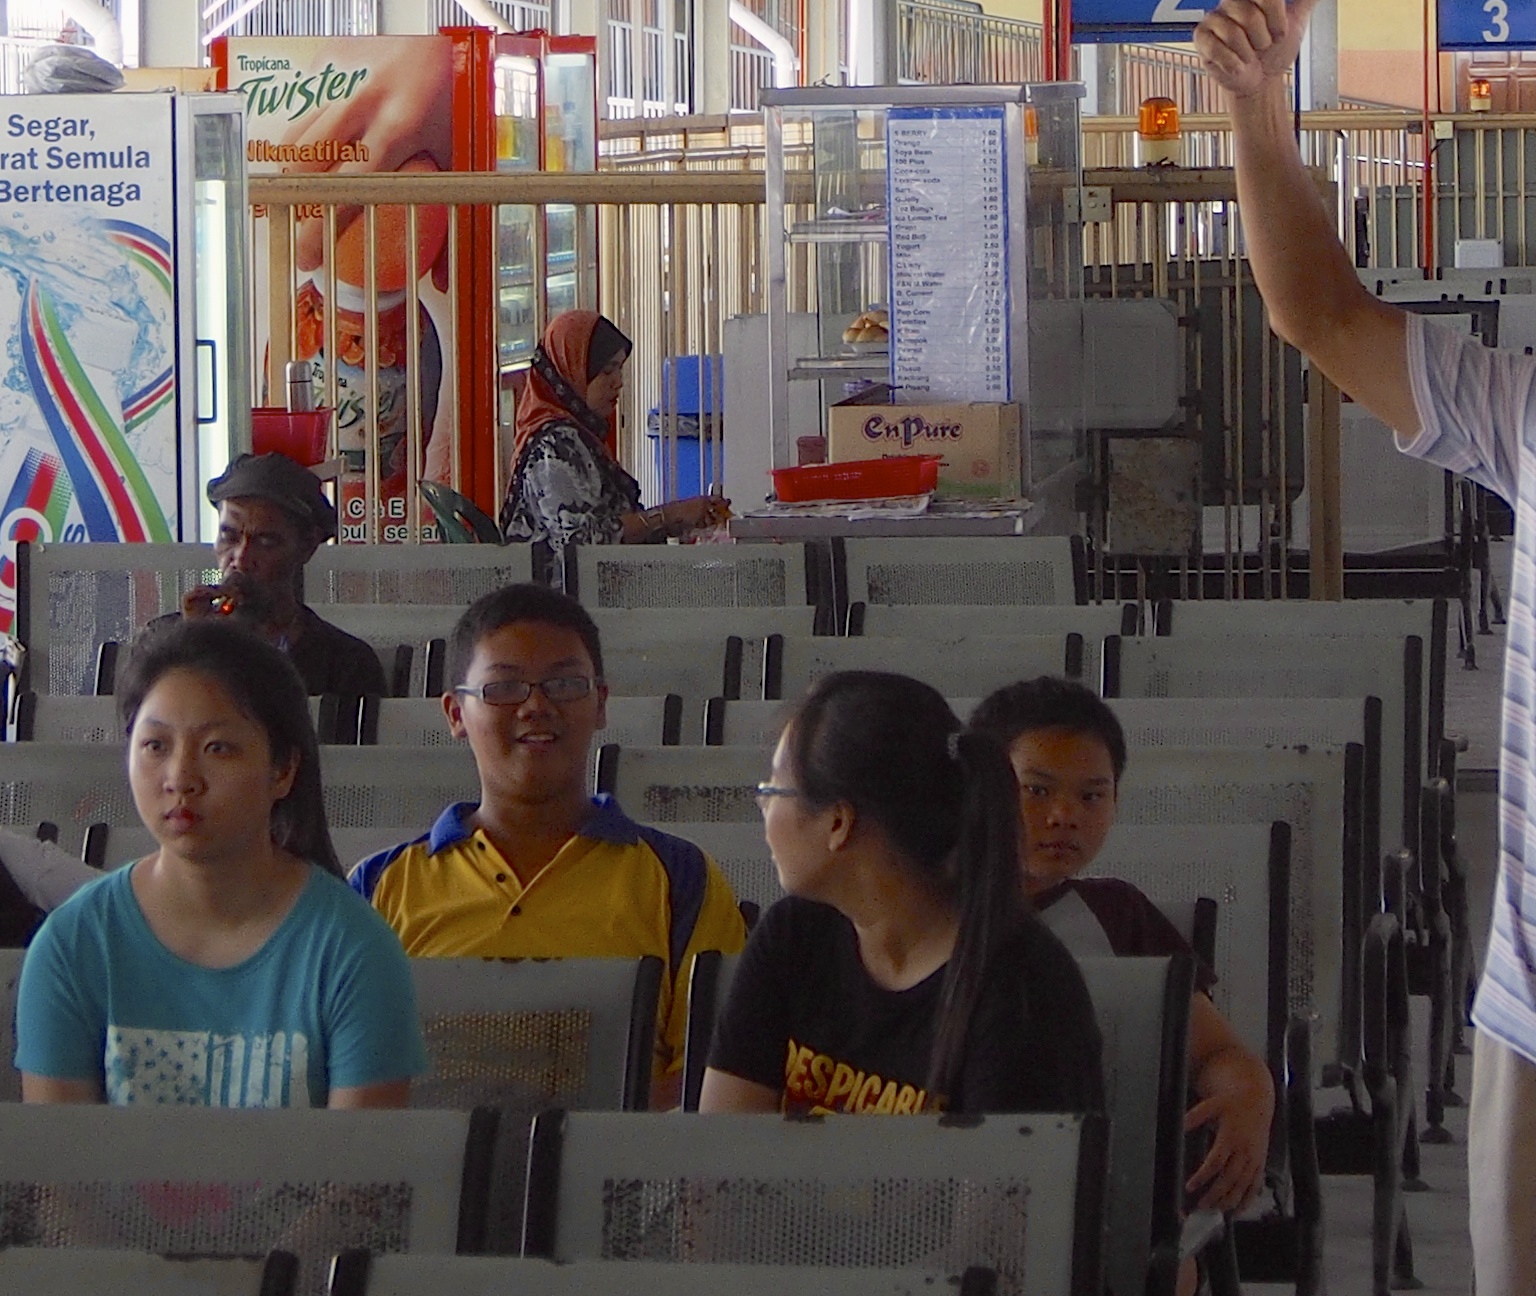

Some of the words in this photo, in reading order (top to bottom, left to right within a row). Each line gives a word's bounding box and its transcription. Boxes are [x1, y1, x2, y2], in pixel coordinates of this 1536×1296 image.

[236, 55, 292, 72] Tropicana
[241, 62, 368, 121] Twister
[7, 114, 96, 141] Segar,
[46, 145, 151, 170] Semula
[391, 499, 403, 516] E
